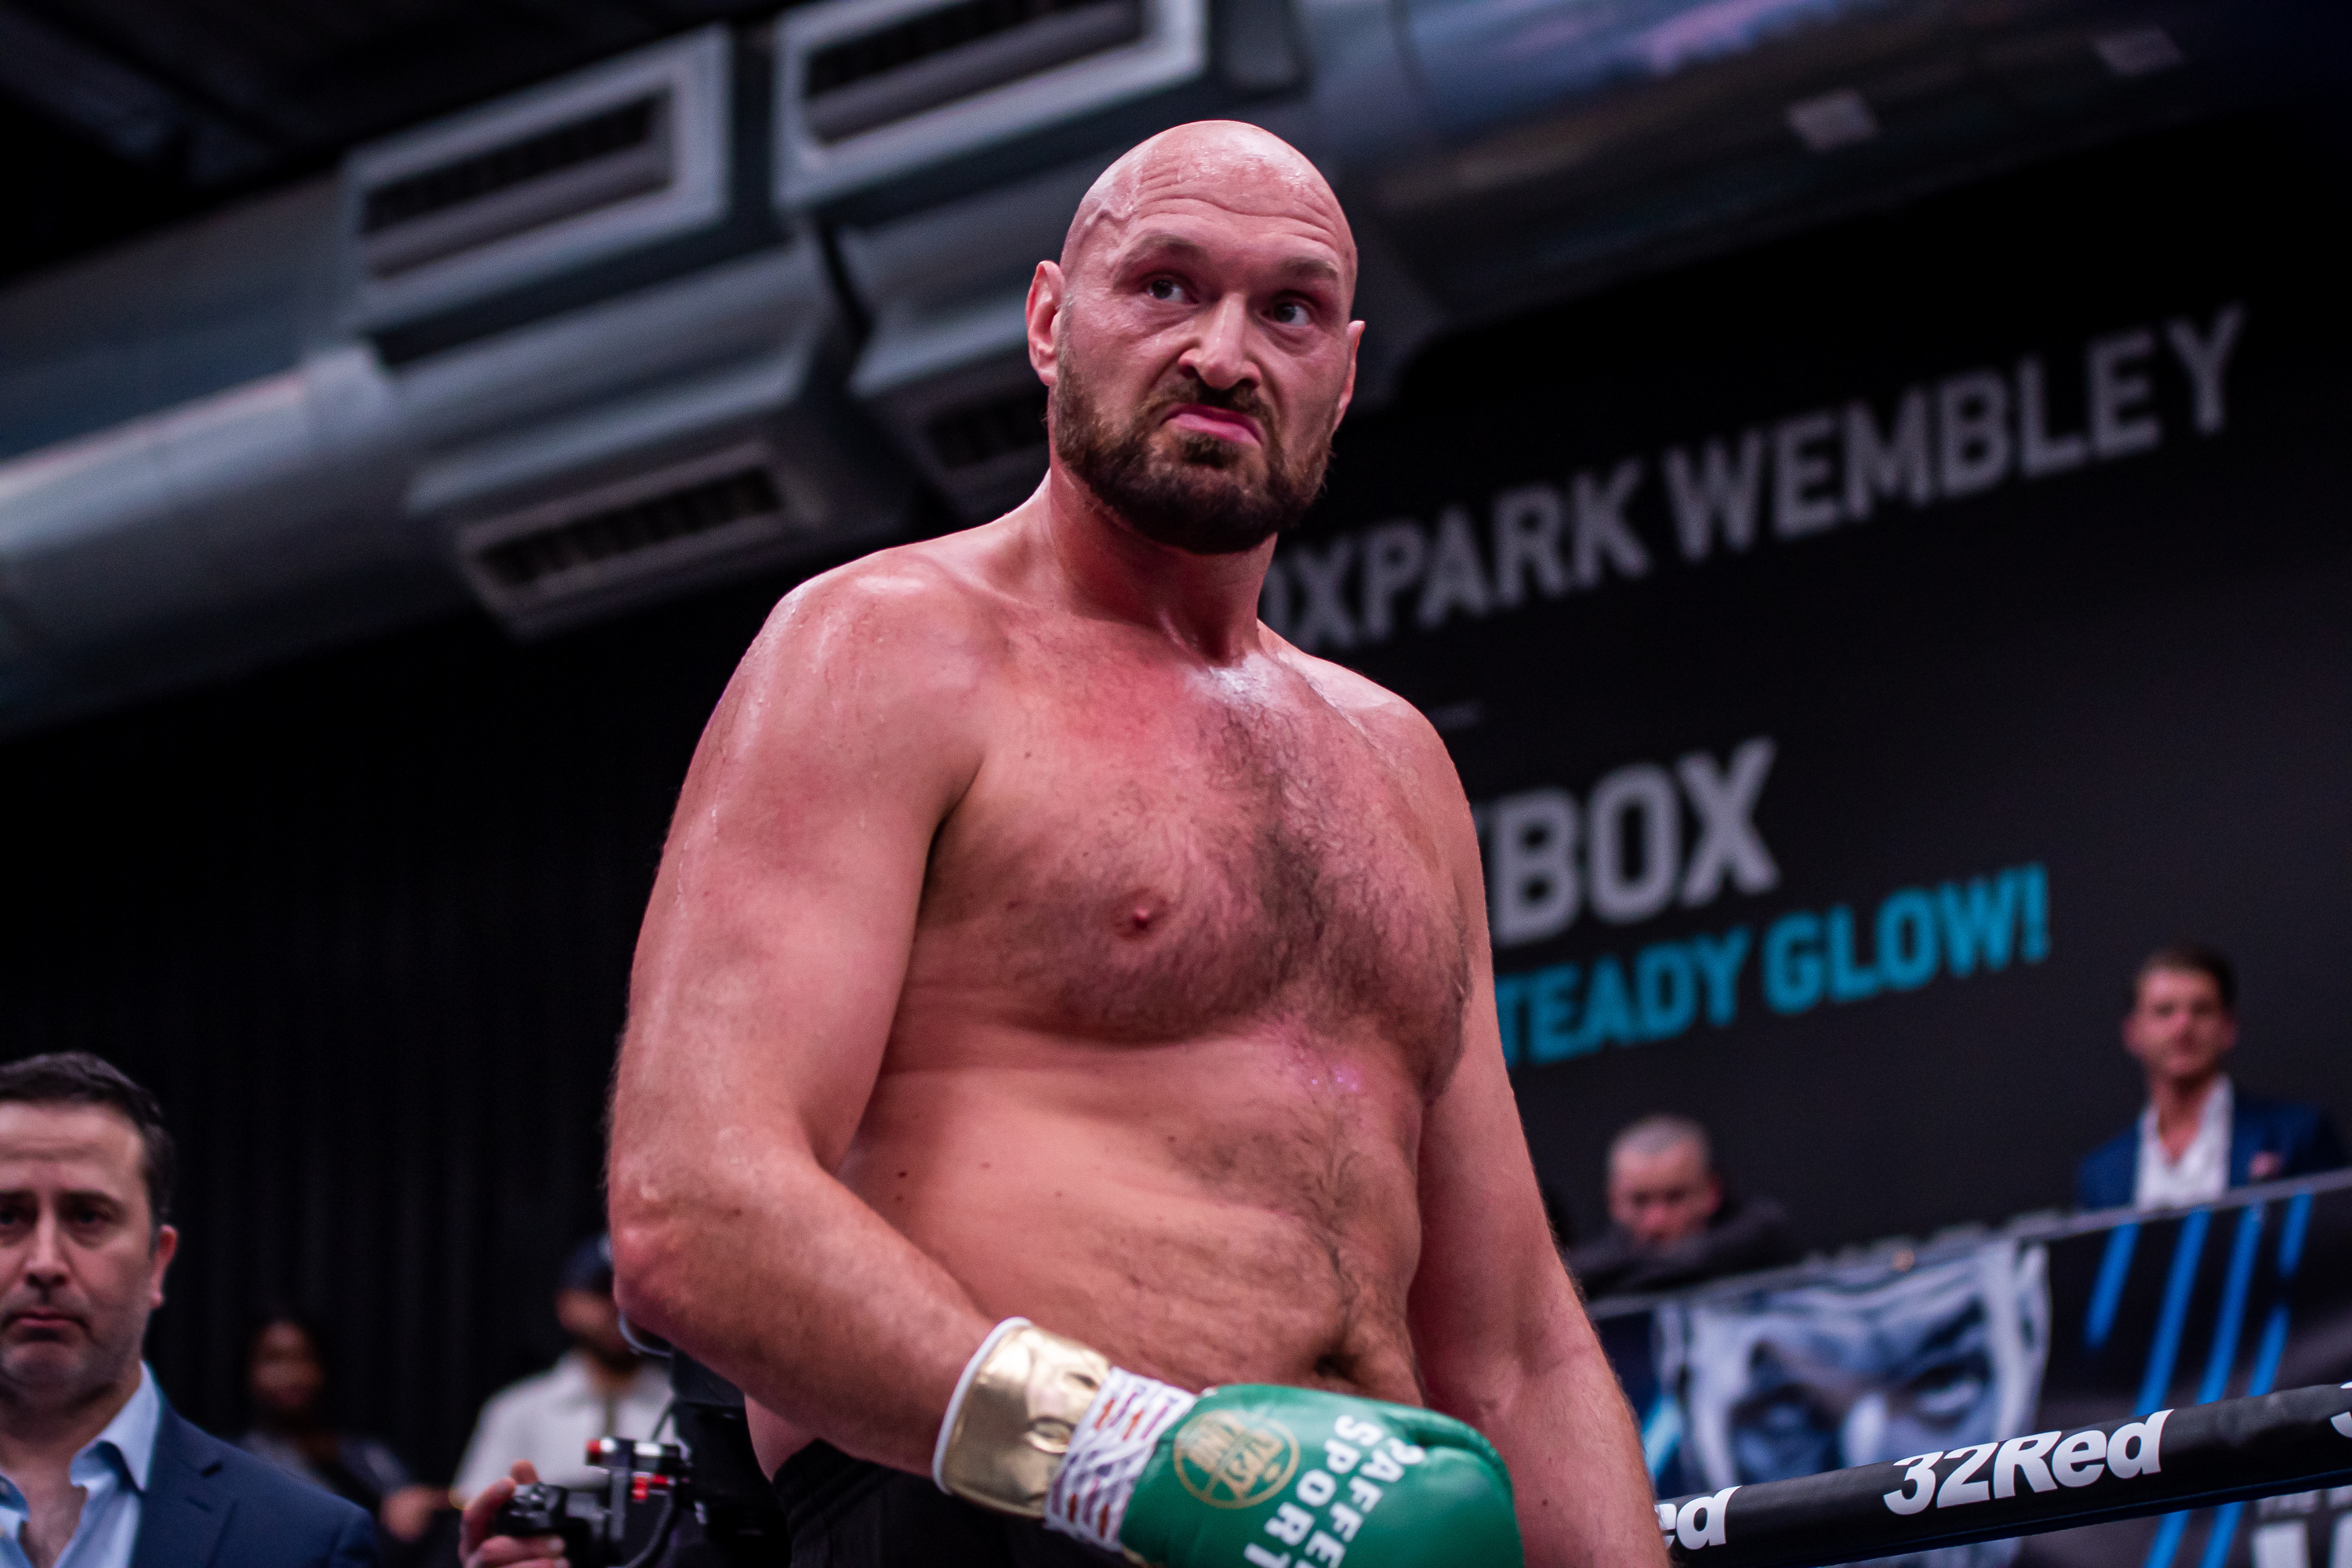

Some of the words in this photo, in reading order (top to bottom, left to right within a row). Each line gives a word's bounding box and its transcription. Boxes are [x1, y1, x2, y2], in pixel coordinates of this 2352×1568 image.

[1663, 301, 2245, 563] WEMBLEY
[1471, 735, 1779, 946] BOX
[1762, 861, 2049, 1014] GLOW!
[1243, 1414, 1383, 1568] SPORT
[1294, 1436, 1426, 1568] PAFFE
[1883, 1409, 2174, 1516] 32Red
